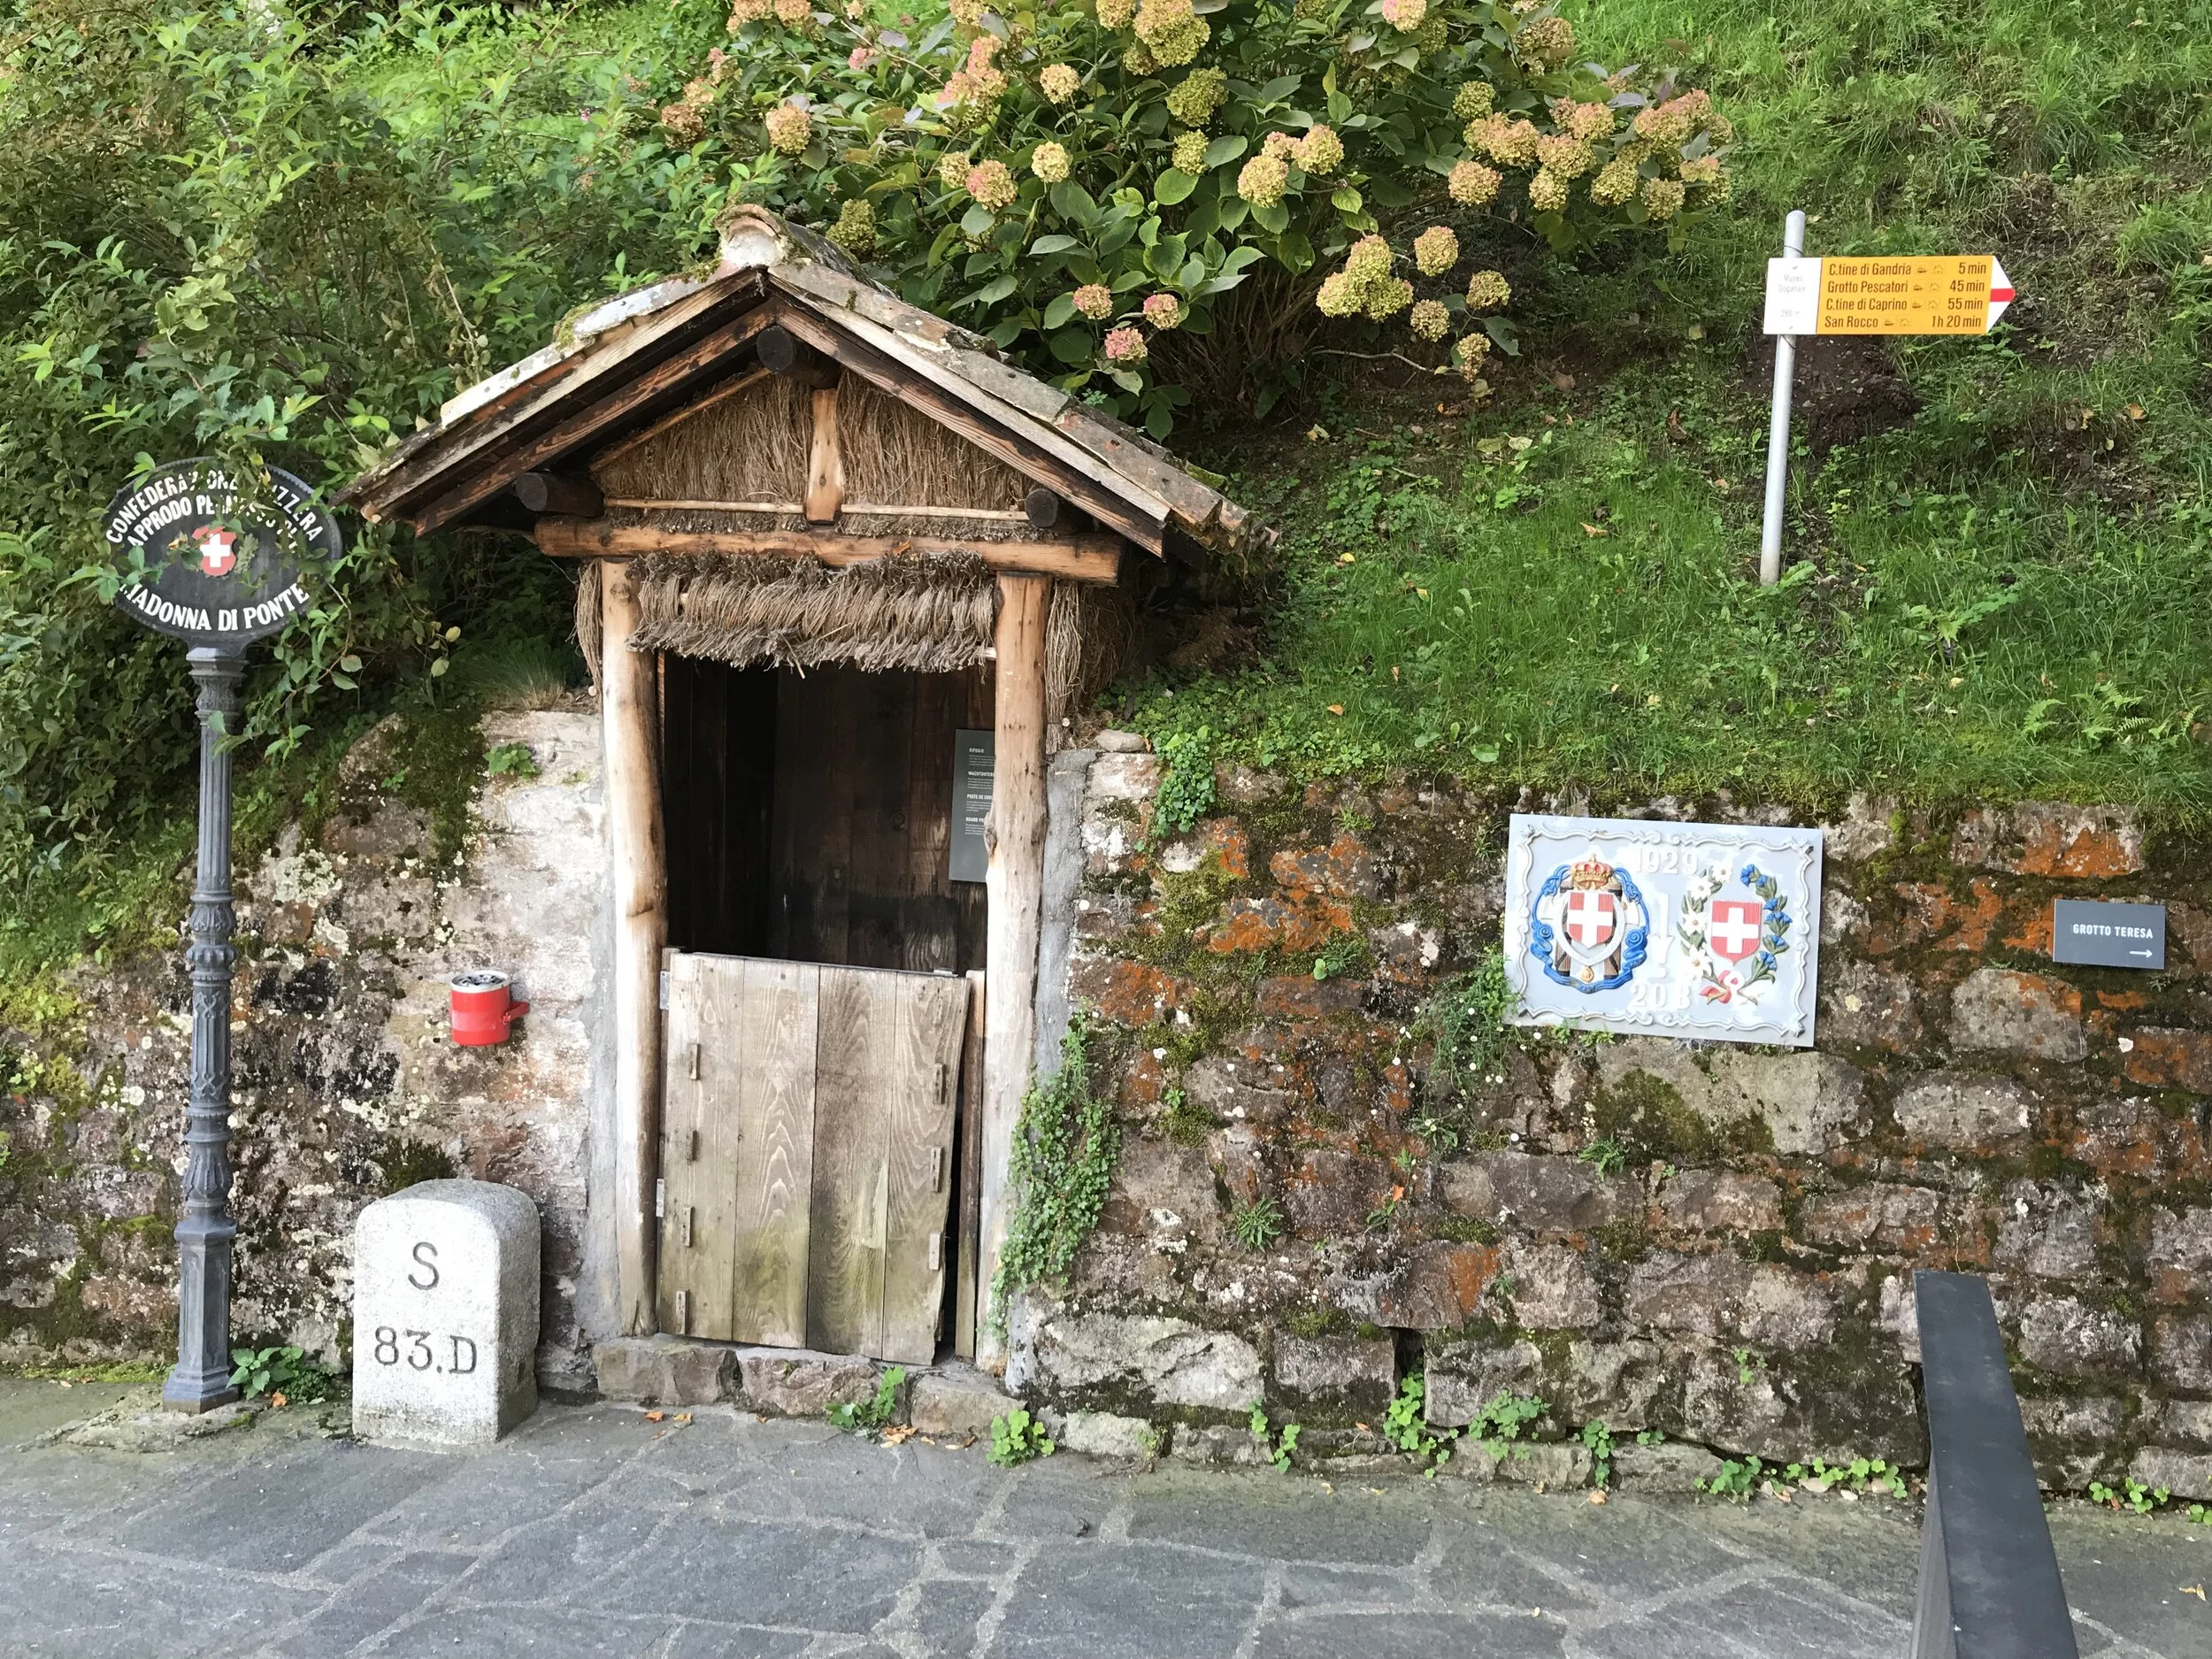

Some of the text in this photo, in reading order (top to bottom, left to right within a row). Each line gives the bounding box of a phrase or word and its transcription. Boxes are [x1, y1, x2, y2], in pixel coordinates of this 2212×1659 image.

[1829, 262, 1986, 276] C.tine di Gandria 5 min
[1828, 280, 1985, 293] Grotto Pescatori 45 min
[1826, 297, 1983, 312] C.tine di Caprino 55 min
[1824, 315, 1844, 327] San
[1847, 315, 1878, 327] Rocco
[1946, 315, 1961, 327] 20
[1962, 316, 1981, 327] min
[106, 470, 238, 543] CONFEDERAZONE
[127, 496, 192, 548] APPRODO
[218, 609, 239, 631] DI
[242, 582, 310, 629] PONTE
[1634, 847, 1699, 875] 1929
[2072, 923, 2154, 939] GROTTO TERESA
[407, 1240, 440, 1291] S
